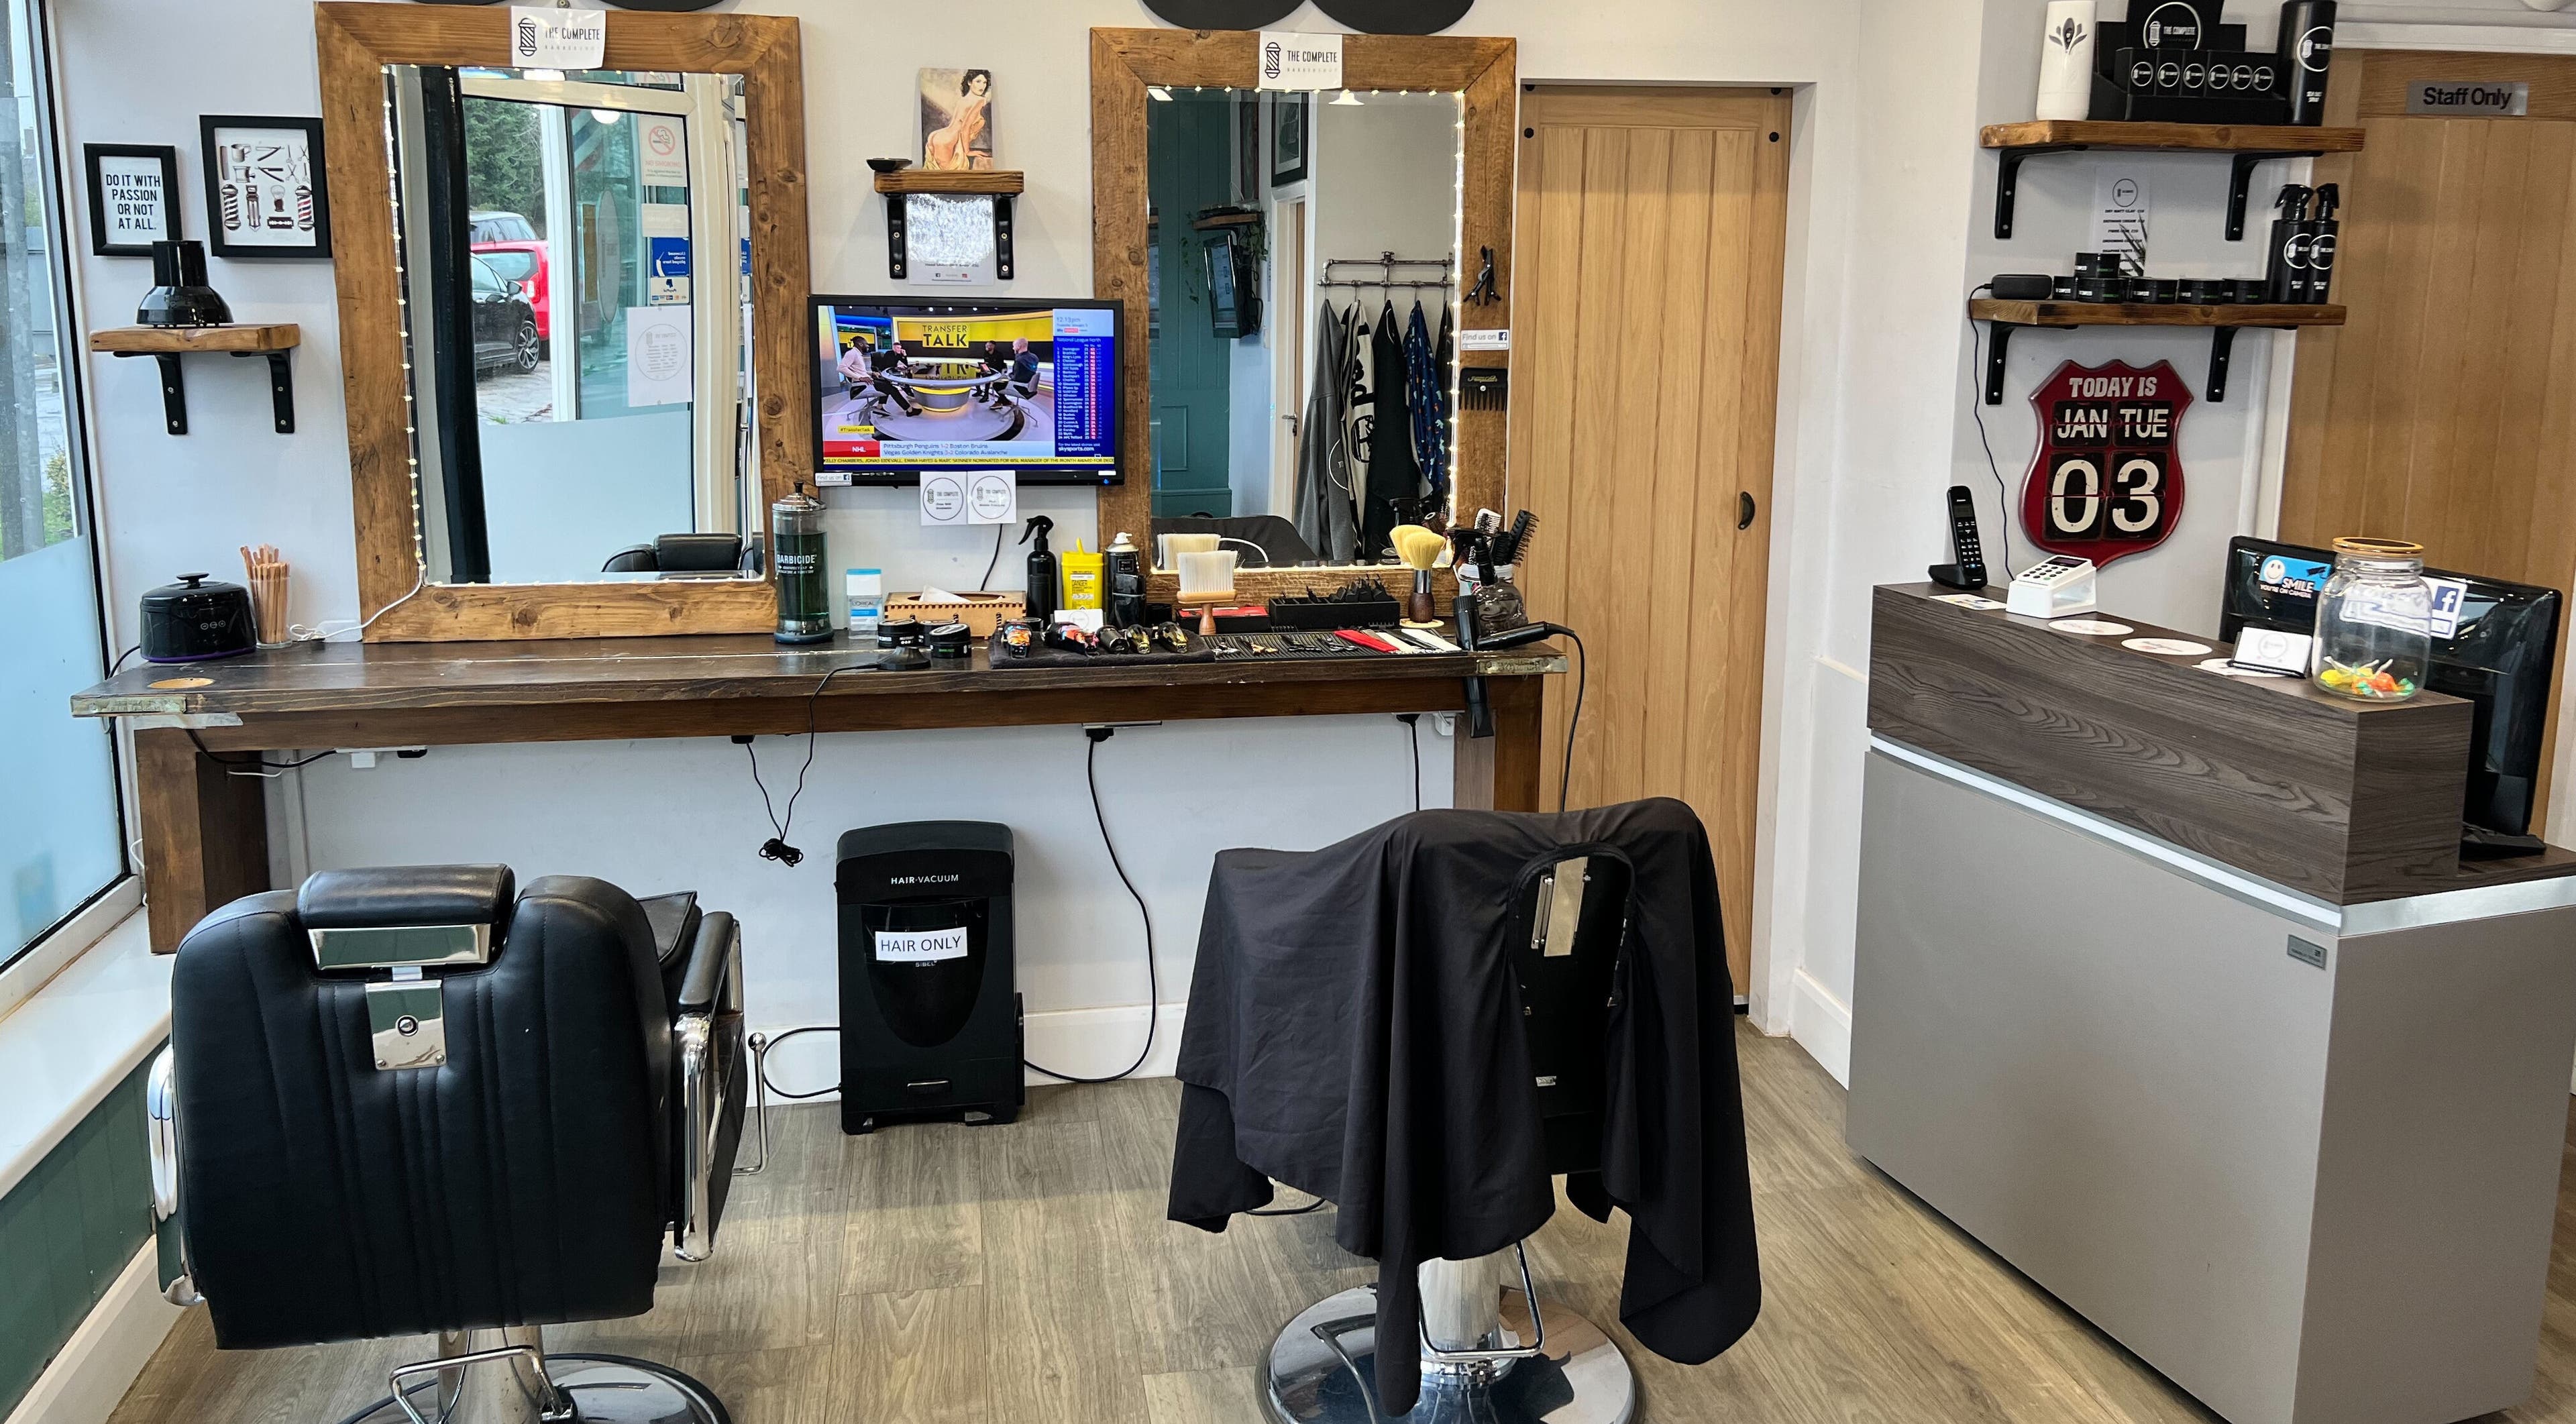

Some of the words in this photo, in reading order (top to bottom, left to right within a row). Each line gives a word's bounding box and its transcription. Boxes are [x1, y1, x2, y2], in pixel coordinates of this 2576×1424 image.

[561, 28, 600, 40] COMPLETE
[1287, 50, 1299, 62] THE
[1302, 51, 1337, 62] COMPLETE
[2423, 87, 2469, 106] Staff
[2471, 87, 2513, 110] Only
[106, 174, 119, 186] DO
[121, 174, 131, 186] IT
[134, 175, 160, 186] WITH
[112, 188, 157, 201] PASSION
[117, 203, 131, 215] OR
[133, 203, 154, 215] NOT
[119, 217, 131, 229] AT
[135, 218, 156, 229] ALL.
[922, 325, 967, 333] TRANSFER
[923, 333, 967, 347] TALK
[2069, 377, 2134, 398] TODAY
[2137, 377, 2157, 397] IS
[2057, 408, 2108, 439] JAN
[2119, 408, 2169, 437] TUE
[2051, 459, 2159, 533] 03
[2260, 584, 2279, 593] YOU'RE
[2288, 590, 2312, 599] CAMERA
[2282, 578, 2315, 593] SMILE
[881, 939, 916, 952] HAIR
[921, 935, 961, 951] ONLY
